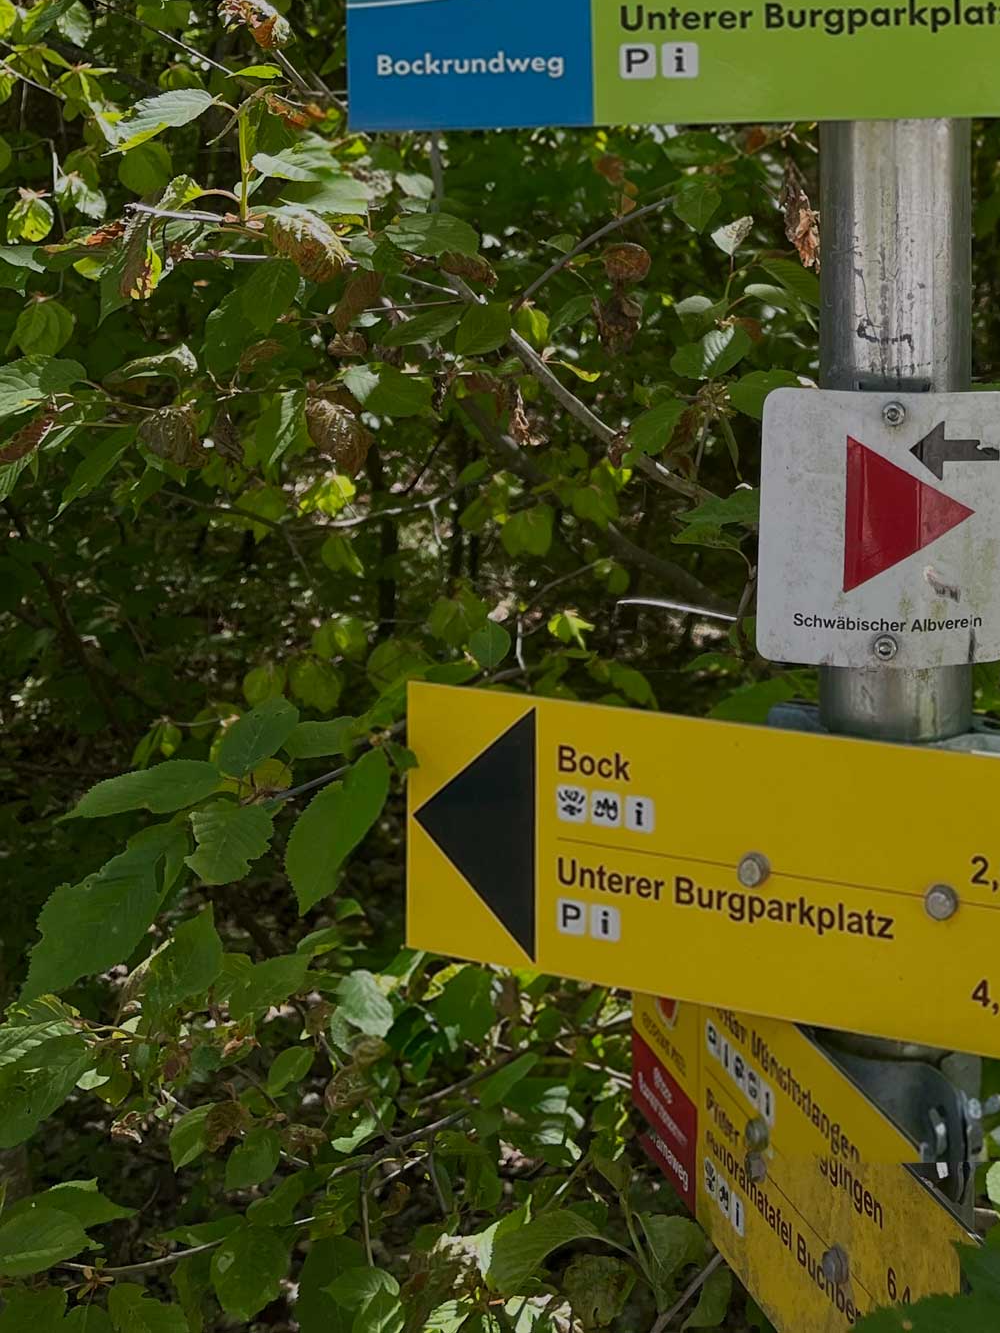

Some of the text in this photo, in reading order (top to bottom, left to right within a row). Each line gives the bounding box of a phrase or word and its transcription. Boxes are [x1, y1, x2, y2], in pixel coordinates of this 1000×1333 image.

[620, 4, 754, 32] Unterer
[376, 50, 564, 78] Bockrundweg
[793, 612, 983, 633] Schwäbischer Albverein
[557, 744, 630, 782] Bock
[557, 856, 894, 940] Unterer Burgparkplatz
